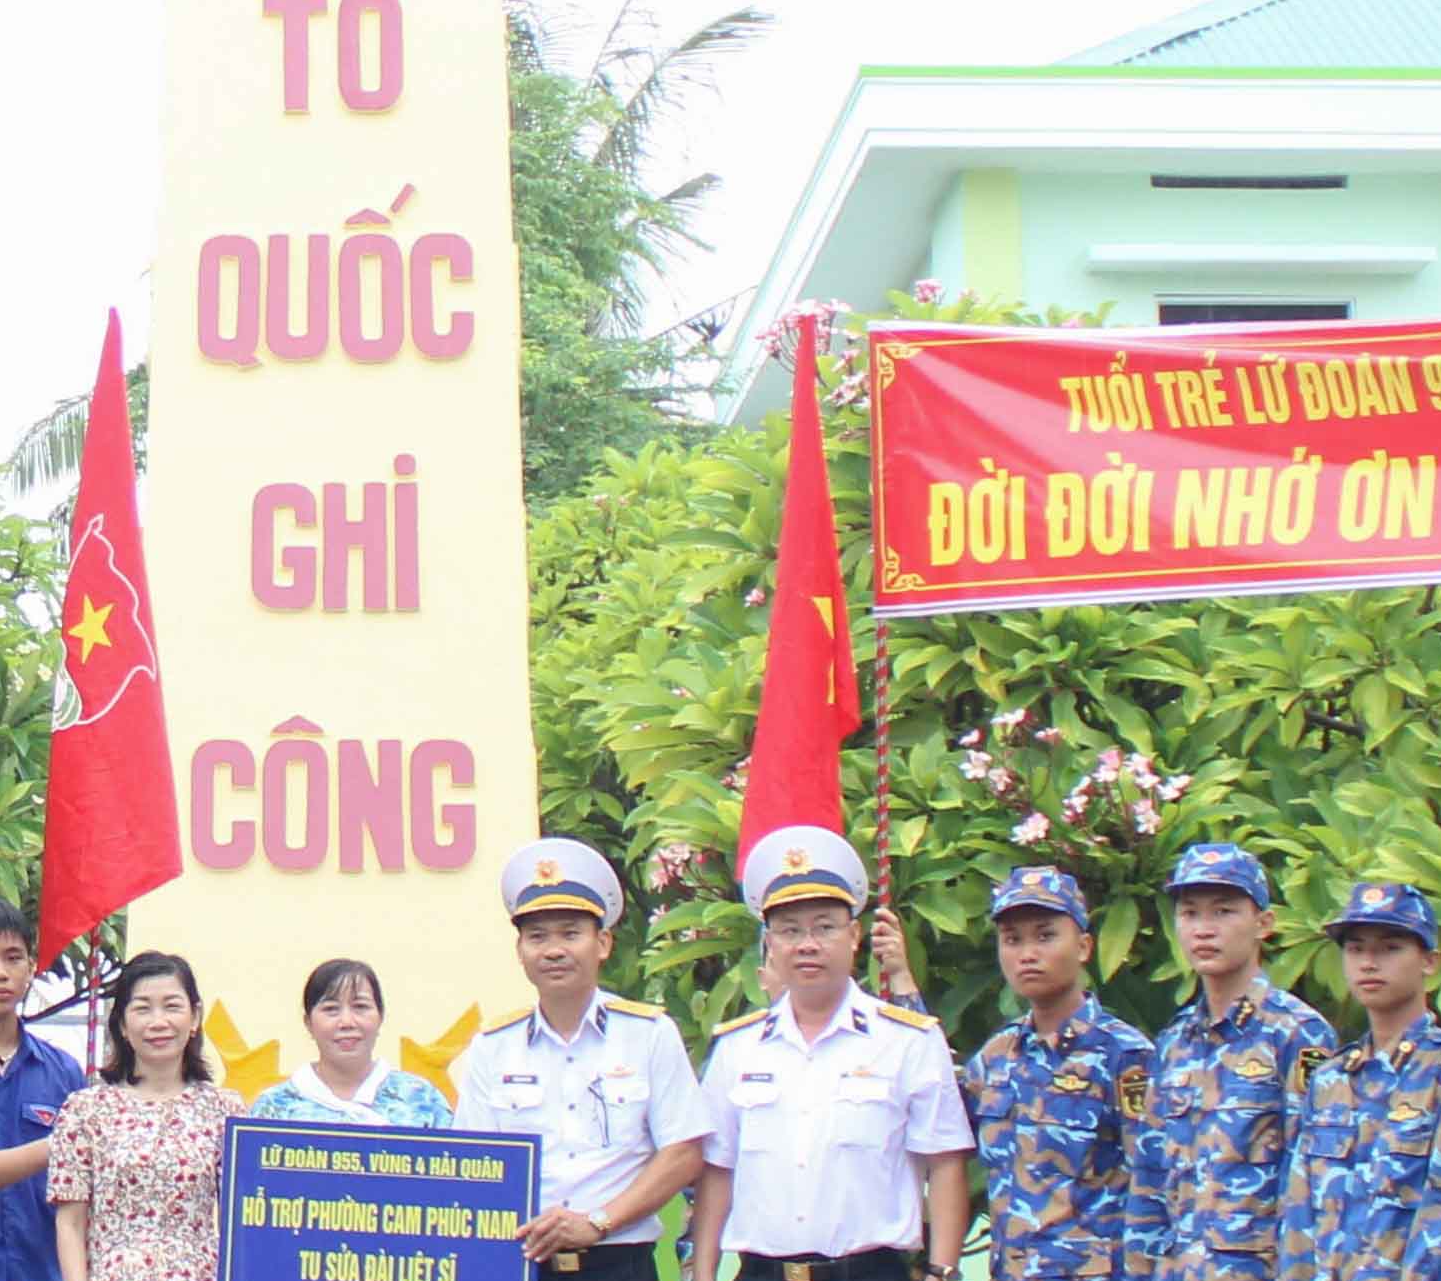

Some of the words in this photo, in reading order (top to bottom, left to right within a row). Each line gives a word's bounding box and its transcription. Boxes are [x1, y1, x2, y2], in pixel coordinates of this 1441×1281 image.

[197, 183, 474, 371] QUỐC
[1060, 350, 1153, 433] TUỔI
[1154, 350, 1234, 428] TRẺ
[1236, 353, 1291, 425] LỮ
[927, 458, 1027, 566] ĐỜI
[1045, 452, 1155, 558] ĐỜI
[1174, 446, 1323, 550] NHỚ
[1338, 449, 1436, 543] ƠN
[190, 715, 477, 875] CÔNG
[370, 1150, 411, 1175] VÙNG
[415, 1156, 426, 1176] 4
[460, 1156, 504, 1180] QUÂN
[270, 1195, 304, 1236] TRỢ
[383, 1203, 422, 1236] CAM
[426, 1201, 472, 1238] PHÚC
[477, 1210, 518, 1241] NAM
[300, 1250, 321, 1281] TU
